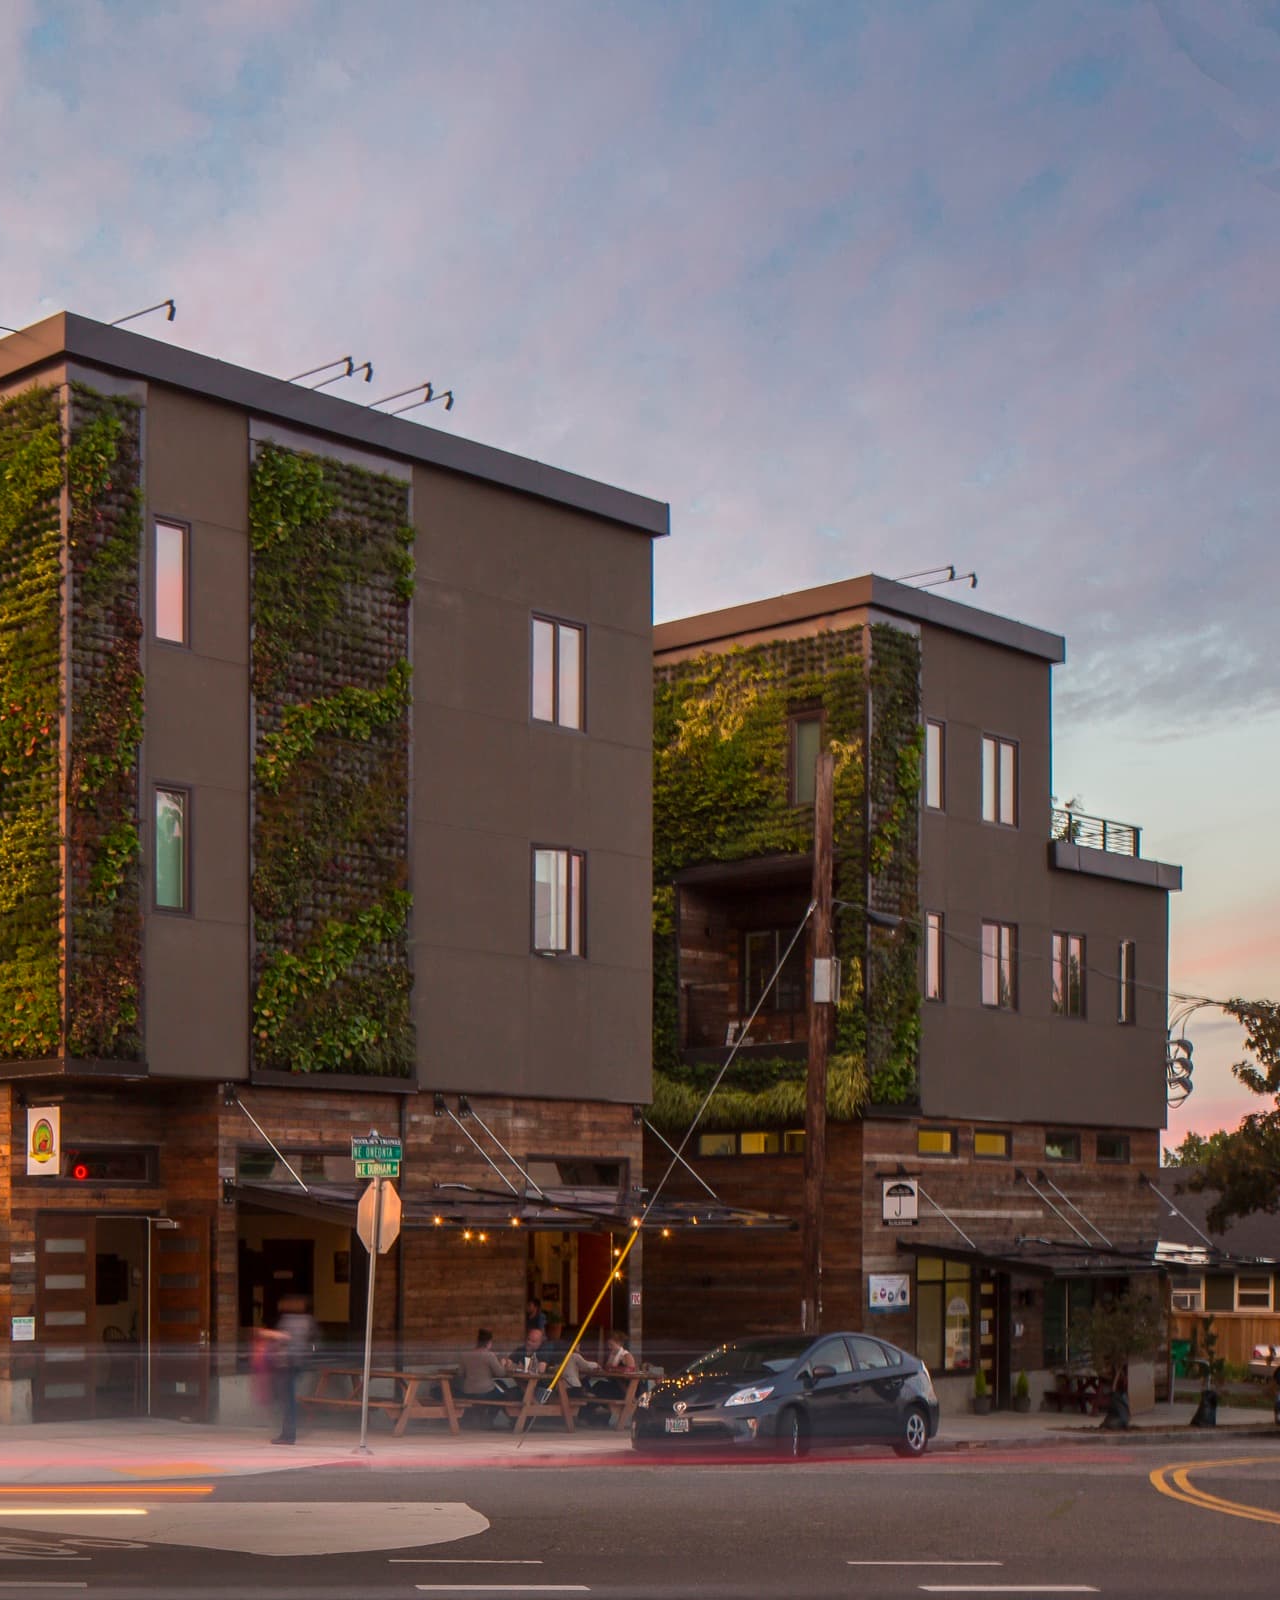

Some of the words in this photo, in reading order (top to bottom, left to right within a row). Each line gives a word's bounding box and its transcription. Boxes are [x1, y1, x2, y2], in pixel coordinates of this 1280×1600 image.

[353, 1147, 362, 1158] NE
[365, 1147, 393, 1158] ONEONTA
[357, 1163, 366, 1176] NE
[367, 1163, 392, 1176] DURHAM
